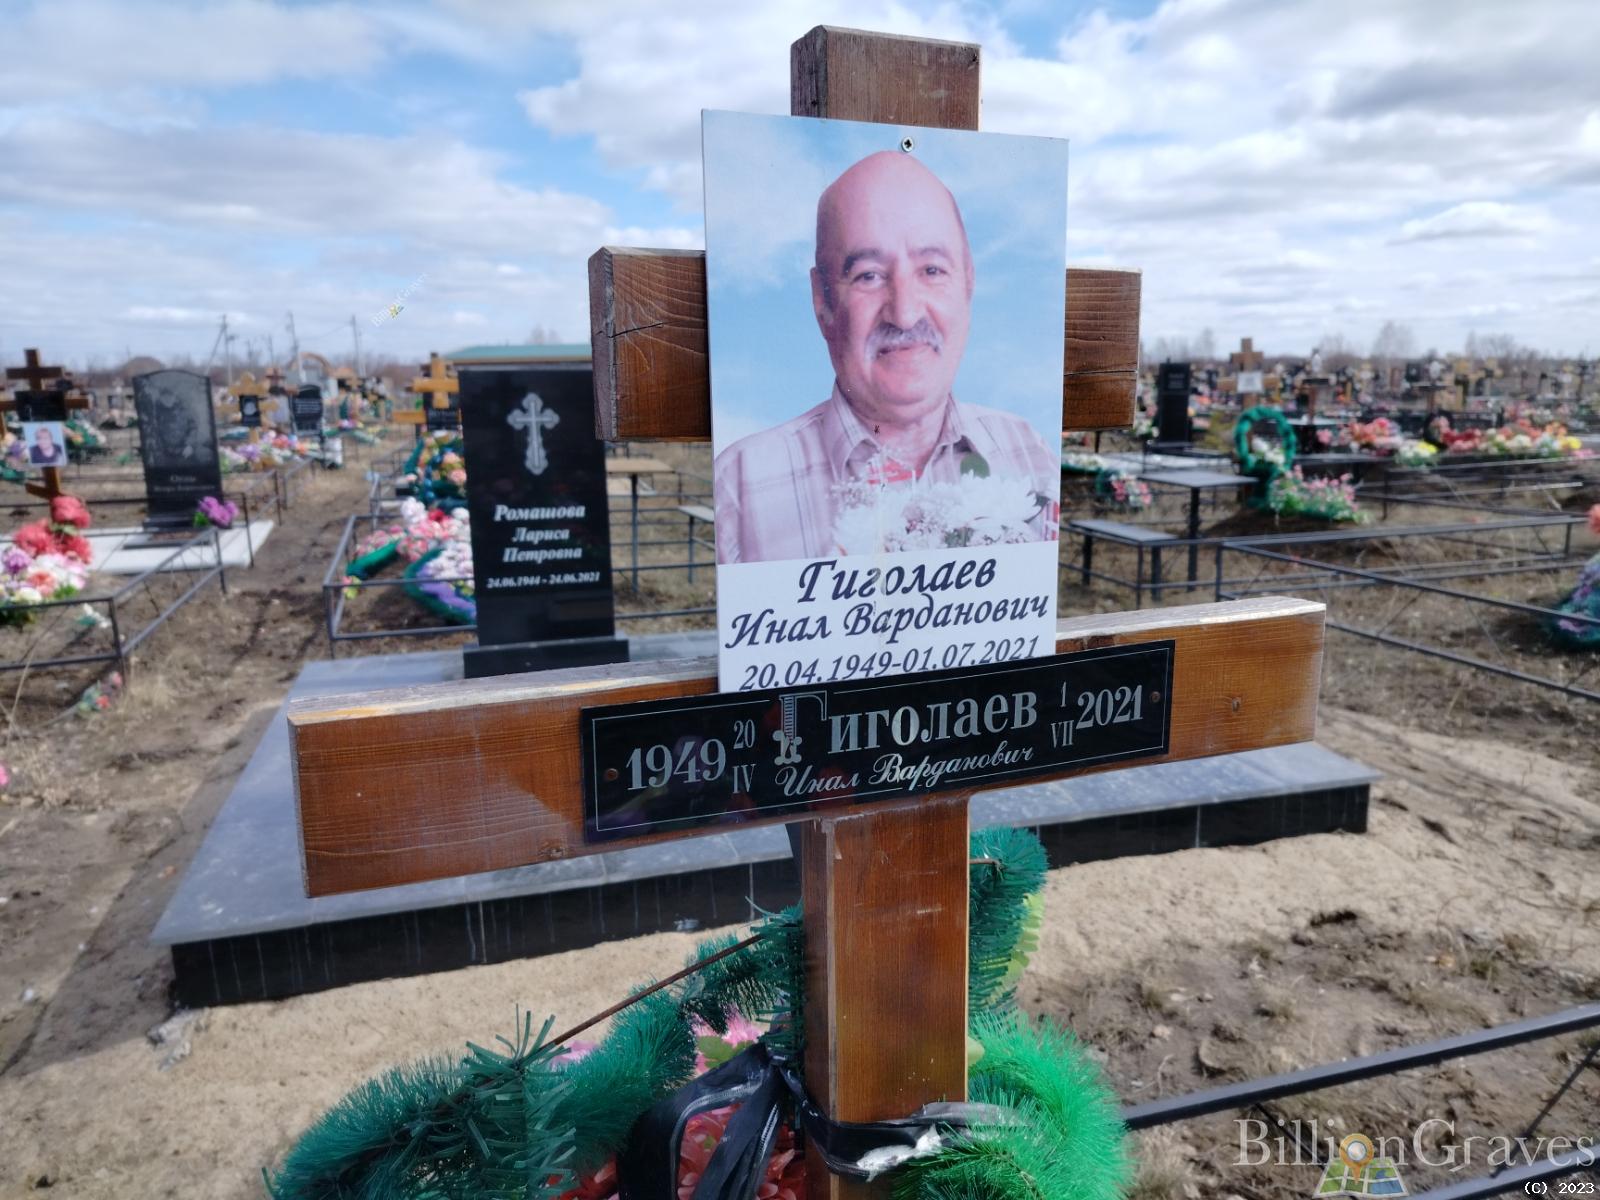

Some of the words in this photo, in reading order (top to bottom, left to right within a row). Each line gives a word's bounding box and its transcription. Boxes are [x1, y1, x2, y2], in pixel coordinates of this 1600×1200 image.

[494, 504, 586, 522] Ромашова
[502, 547, 583, 564] Петровна
[511, 527, 570, 545] Лариса
[797, 558, 997, 603] Гиголаев
[725, 608, 832, 649] Инал
[843, 593, 1049, 644] Варданович
[739, 635, 1039, 691] 20.04.1949-01.07.2021
[772, 690, 1037, 766] Гиголаев
[1075, 685, 1144, 730] 2021
[733, 719, 756, 750] 20
[1050, 720, 1075, 748] VII
[625, 738, 727, 791] 1949
[732, 763, 756, 794] IV
[774, 764, 861, 797] Инал
[868, 740, 1034, 791] Варданович
